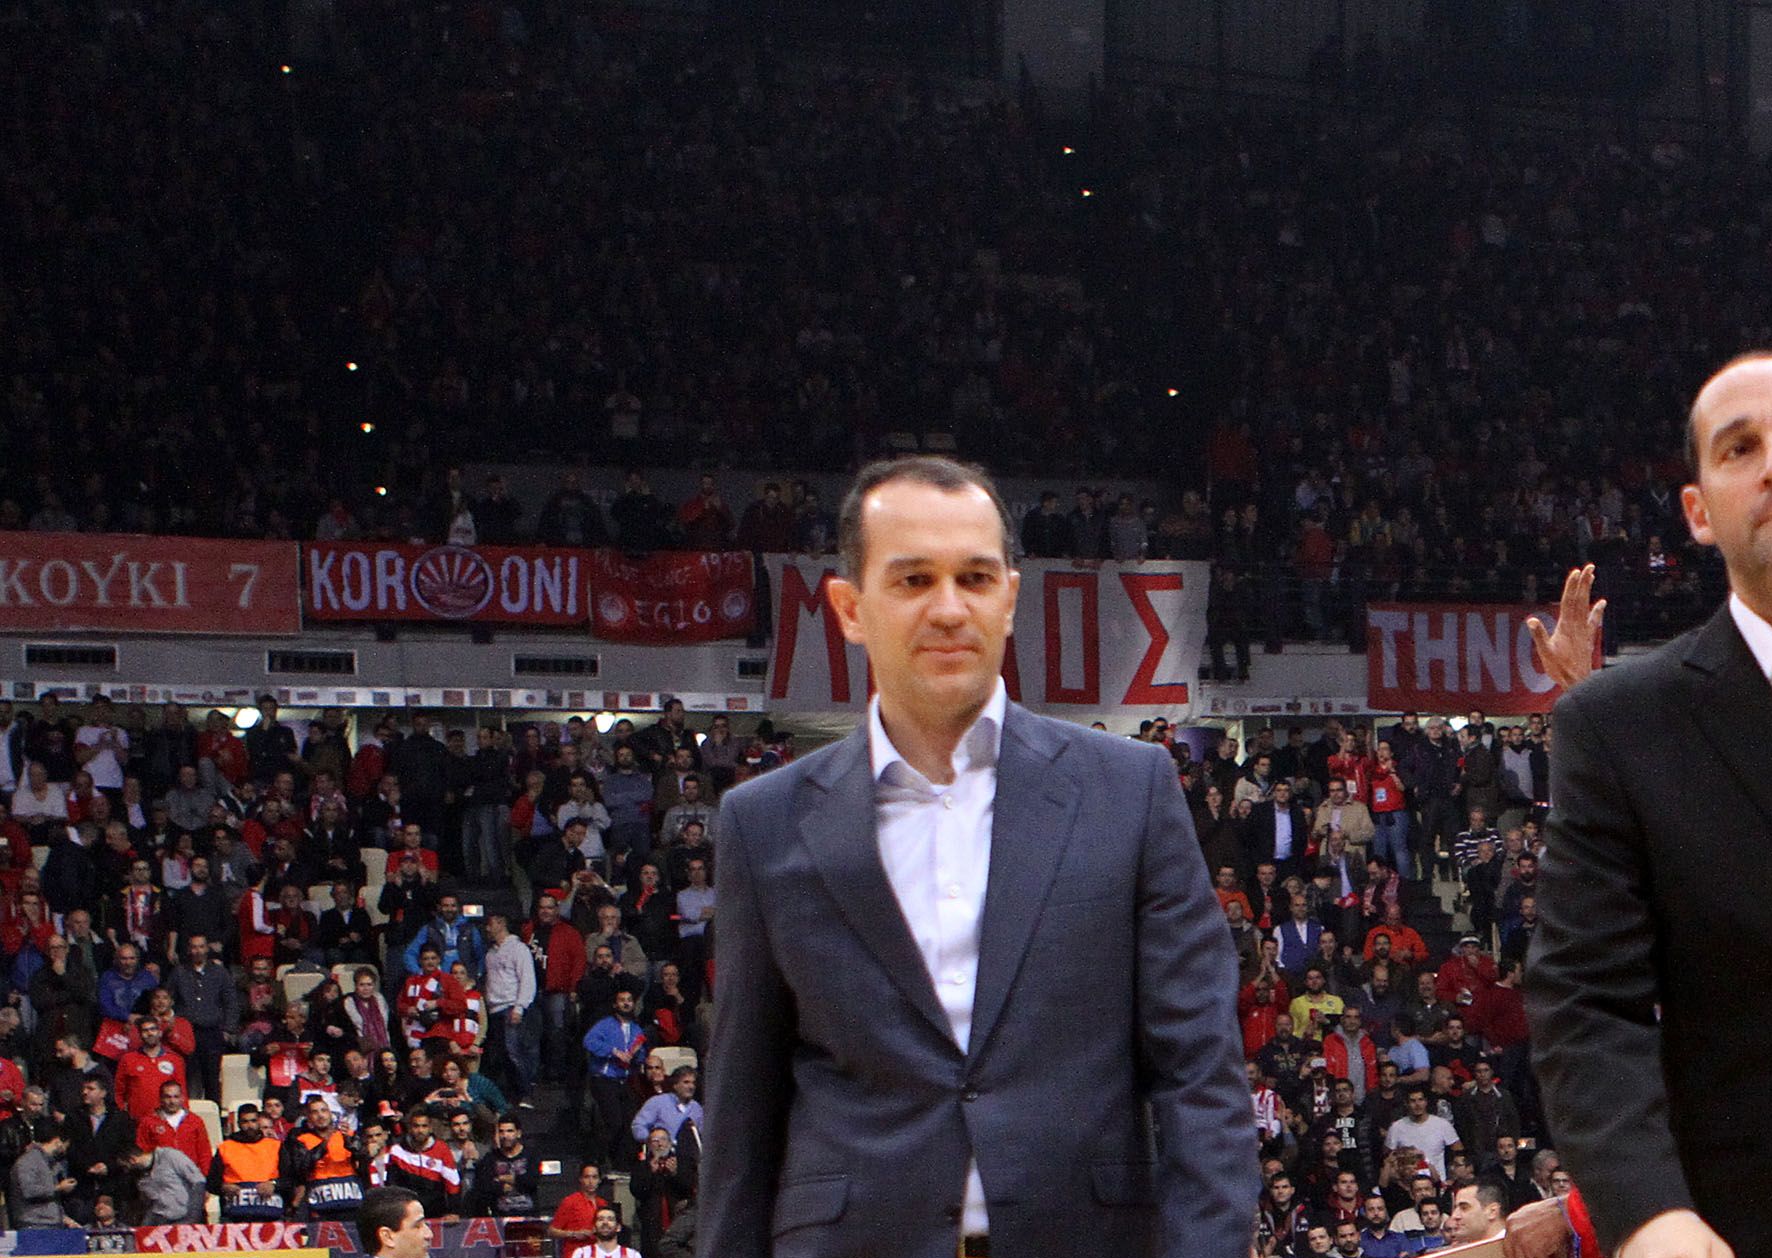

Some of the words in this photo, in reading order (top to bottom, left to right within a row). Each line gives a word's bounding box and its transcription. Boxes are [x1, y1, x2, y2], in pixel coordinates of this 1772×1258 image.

[229, 563, 260, 608] 7
[769, 564, 1189, 705] ΜΟΣ
[1369, 611, 1560, 694] ΤΗΝΟ
